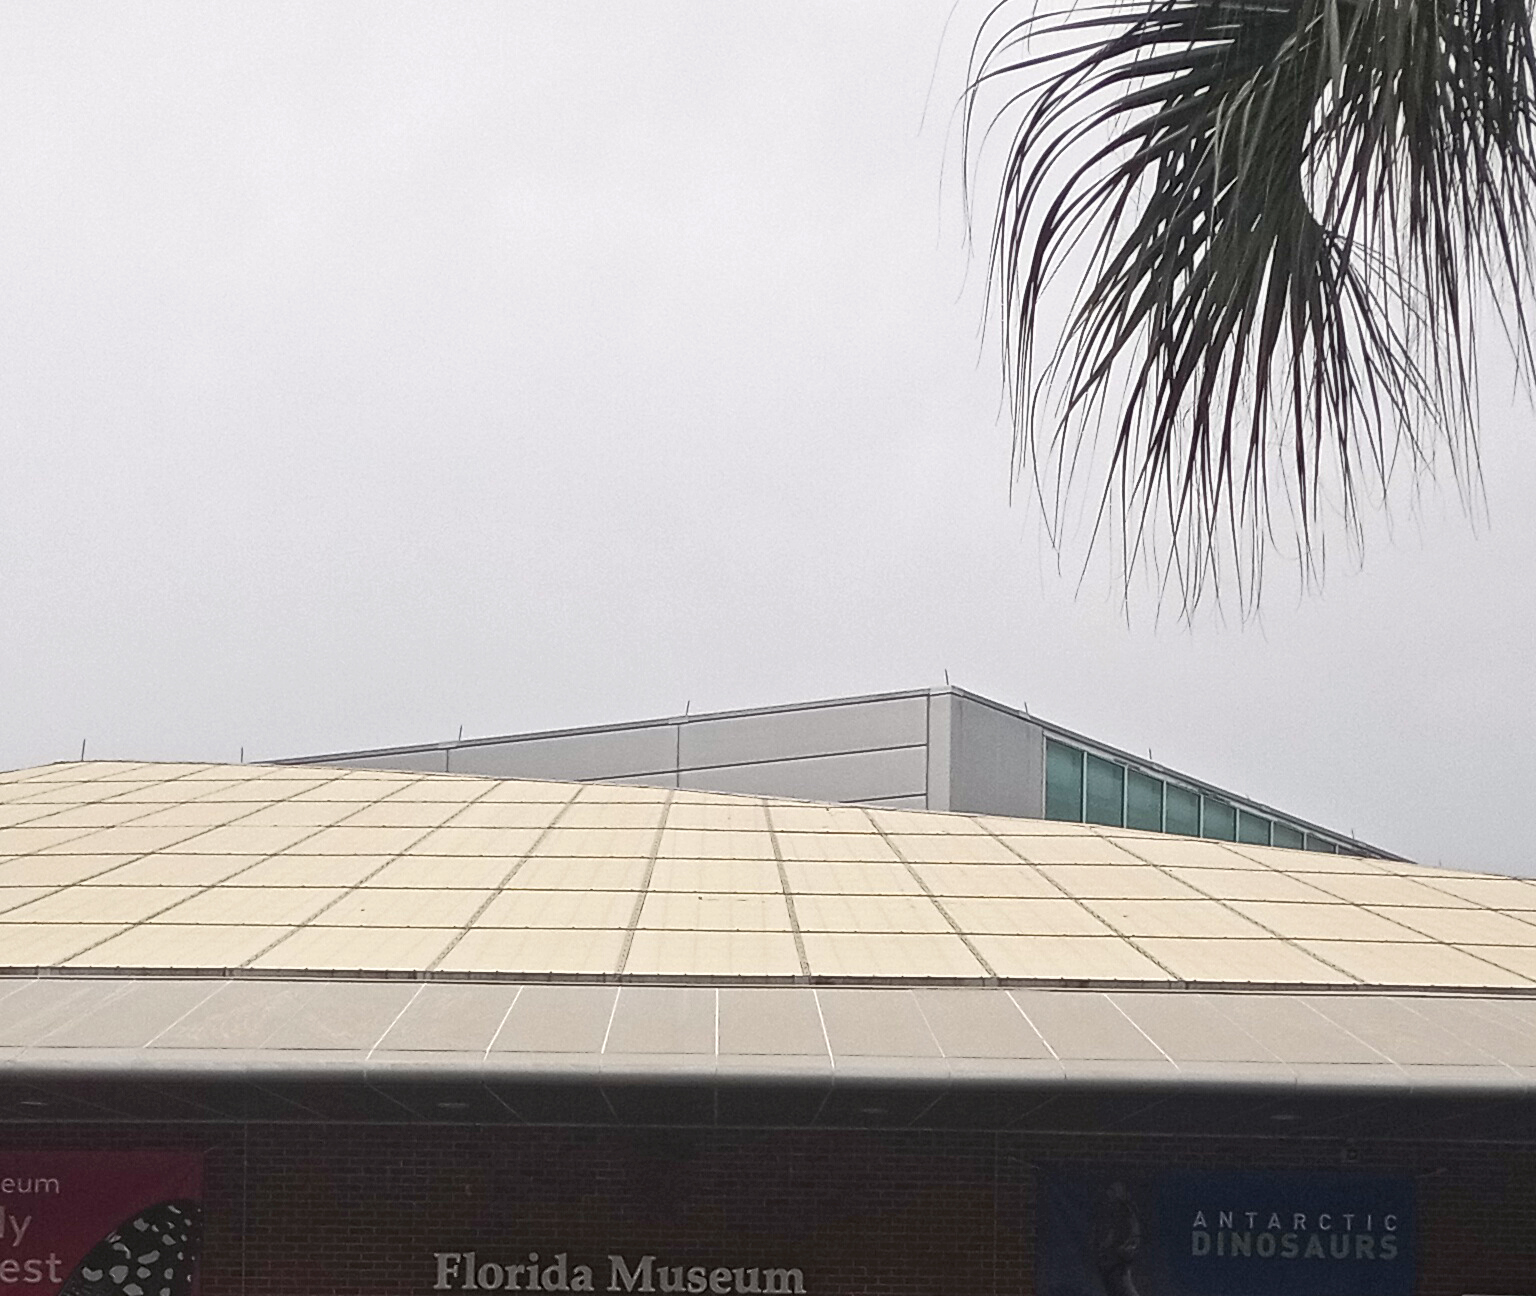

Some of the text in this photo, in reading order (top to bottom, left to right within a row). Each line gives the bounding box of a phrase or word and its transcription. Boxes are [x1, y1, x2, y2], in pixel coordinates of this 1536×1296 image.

[1193, 1210, 1398, 1232] ANTARCTIC
[1191, 1231, 1399, 1260] DINOSAURS
[433, 1251, 806, 1295] Florida Museum
